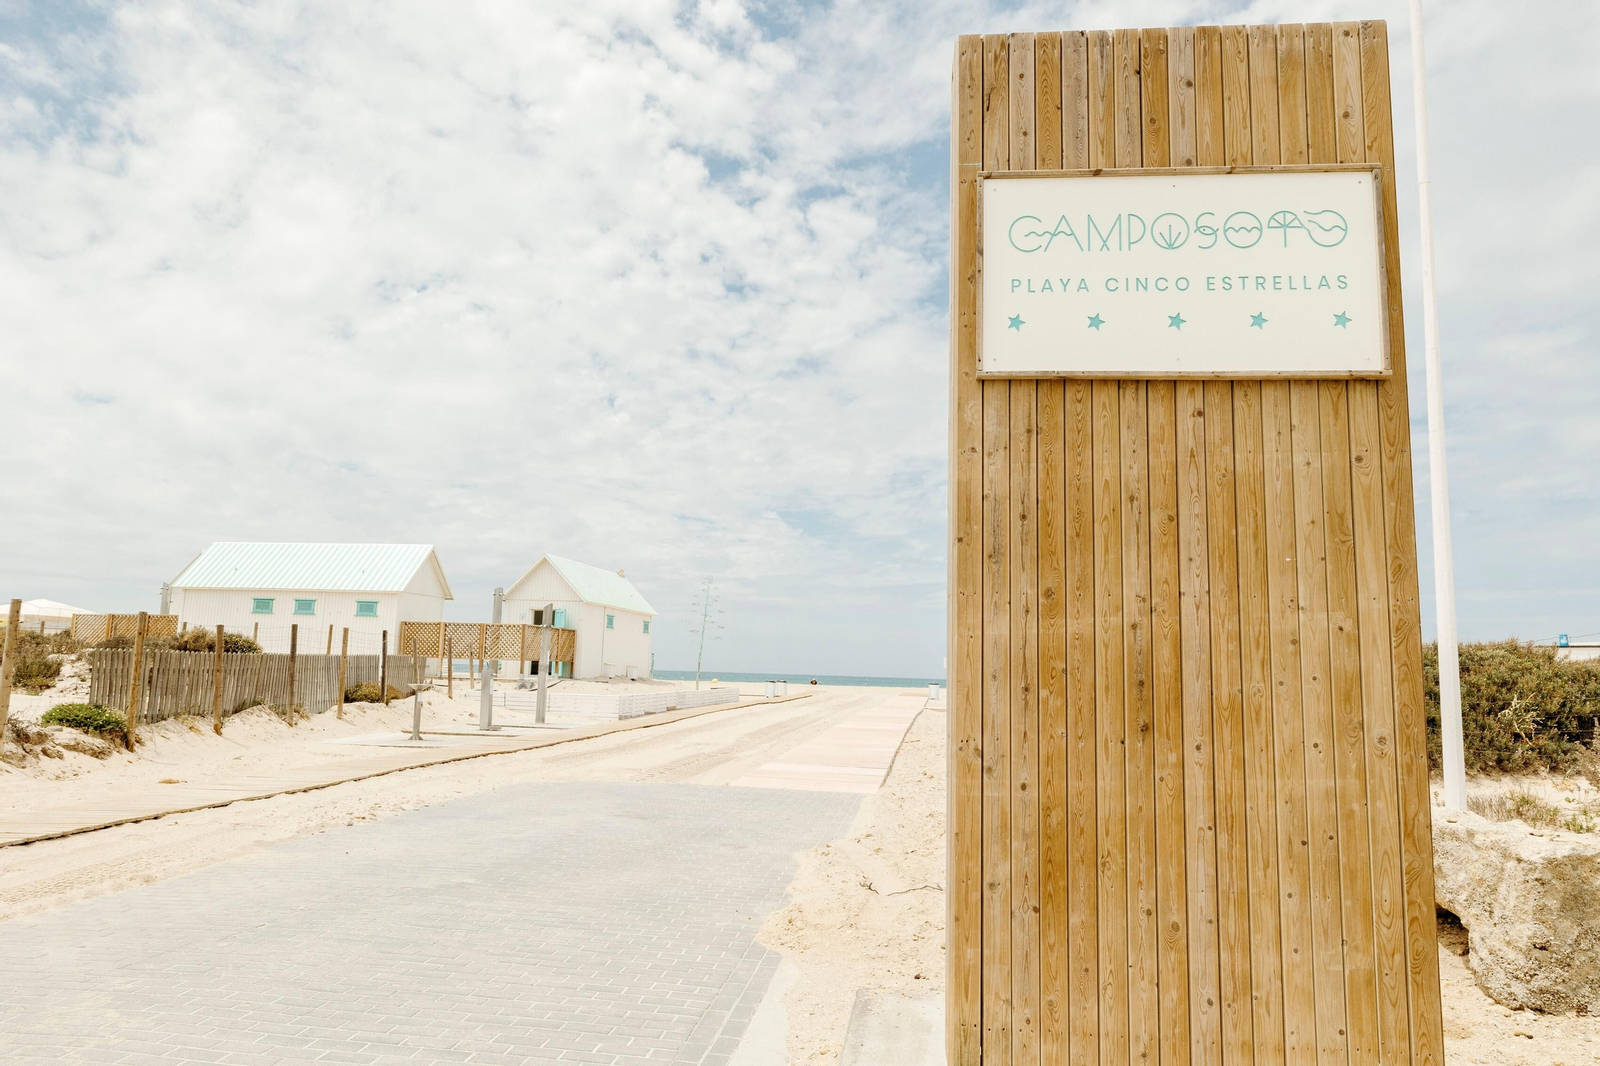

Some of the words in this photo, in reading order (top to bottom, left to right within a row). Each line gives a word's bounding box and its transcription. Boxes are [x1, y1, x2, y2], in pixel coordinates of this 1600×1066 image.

[1008, 210, 1348, 252] CAMPOSOTO
[1011, 278, 1090, 293] PLAYA
[1104, 276, 1190, 292] CINCO
[1206, 274, 1348, 291] ESTRELLAS
